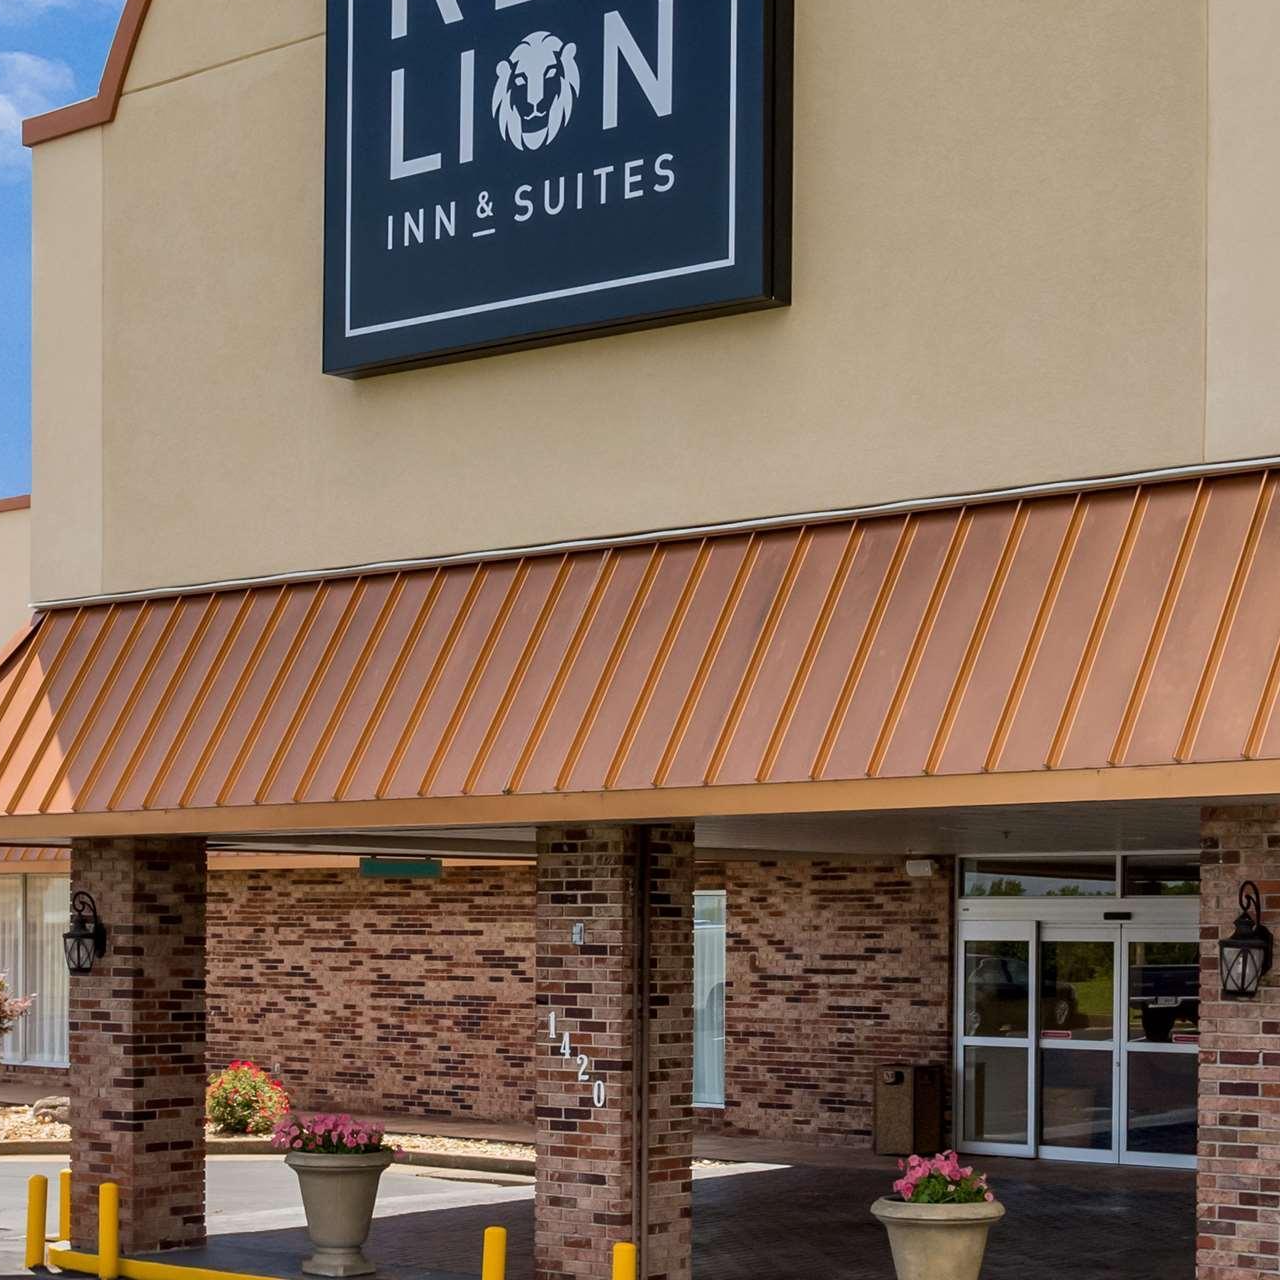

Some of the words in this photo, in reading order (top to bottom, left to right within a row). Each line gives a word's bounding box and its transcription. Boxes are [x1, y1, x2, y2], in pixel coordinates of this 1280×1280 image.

[386, 201, 457, 251] INN
[472, 191, 496, 237] &
[513, 152, 675, 222] SUITES
[548, 1011, 606, 1108] 1420
